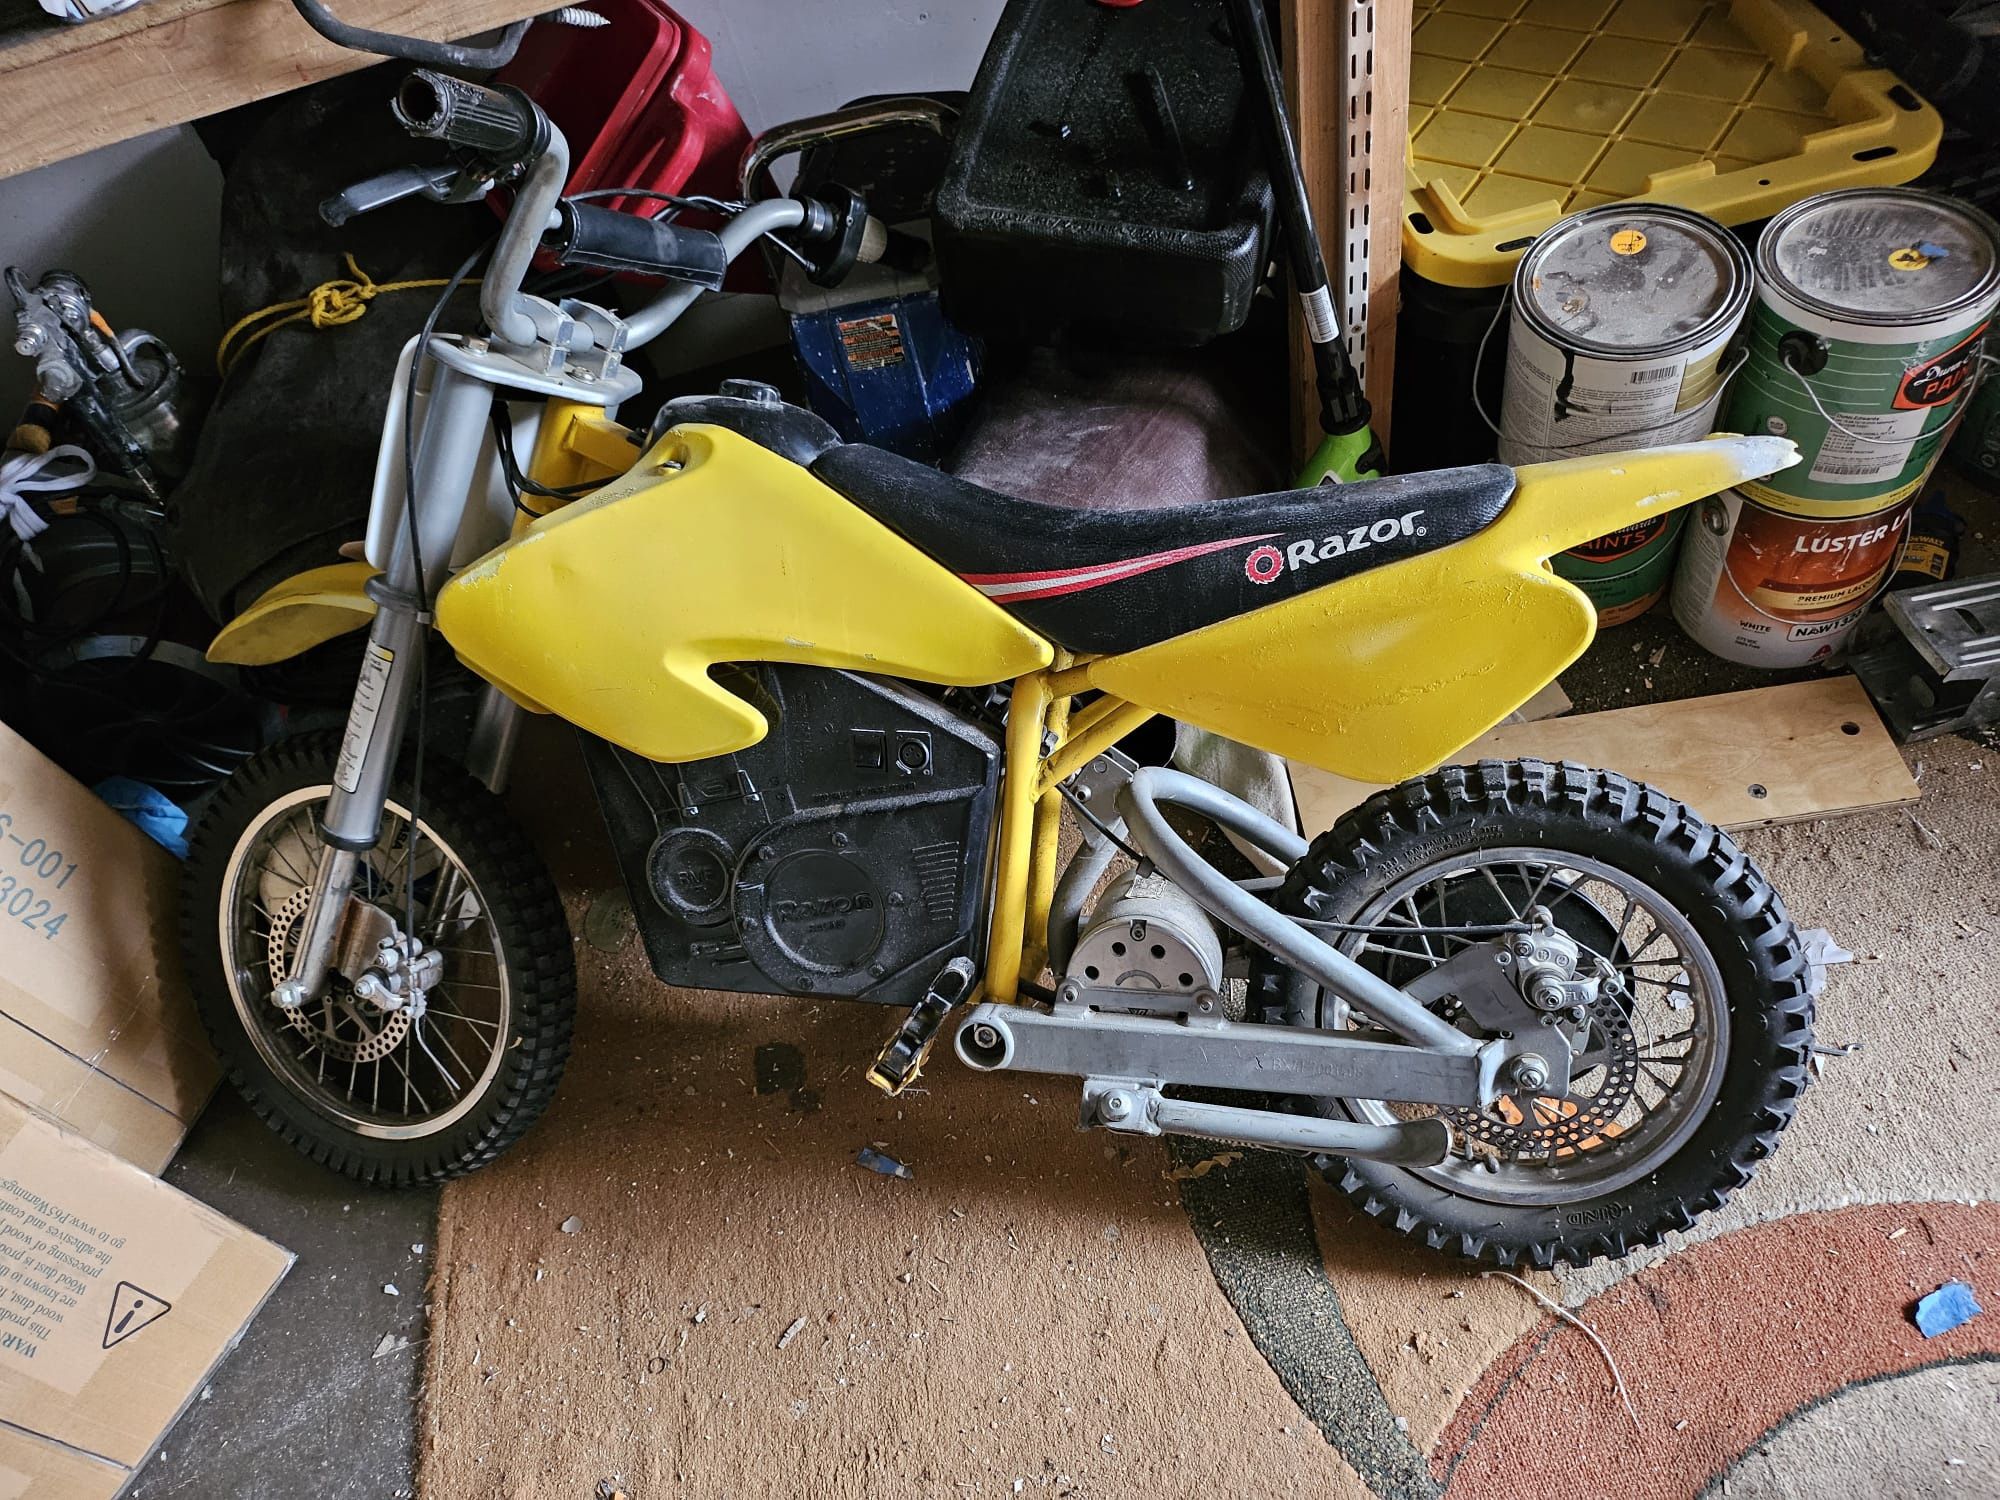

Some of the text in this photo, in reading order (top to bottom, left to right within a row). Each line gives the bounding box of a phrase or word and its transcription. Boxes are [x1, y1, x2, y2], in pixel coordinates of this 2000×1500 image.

[1286, 510, 1425, 572] Razor
[1578, 529, 1647, 550] AINTS
[1795, 524, 1888, 554] LUSTER
[1797, 591, 1845, 603] PREMIUM
[1739, 620, 1772, 633] WHITE
[24, 1212, 48, 1231] and
[2, 1223, 33, 1247] wood
[36, 1237, 48, 1252] of
[48, 1225, 96, 1256] adhesives
[98, 1229, 111, 1243] to
[111, 1236, 128, 1250] go
[24, 1255, 35, 1270] is
[48, 1245, 105, 1280] processing
[96, 1251, 113, 1266] the
[11, 1267, 23, 1284] to
[35, 1259, 58, 1279] dust
[24, 1275, 64, 1303] known
[59, 1273, 88, 1297] Wood
[61, 1294, 78, 1308] are
[37, 1304, 64, 1324] wood
[29, 1321, 52, 1341] This
